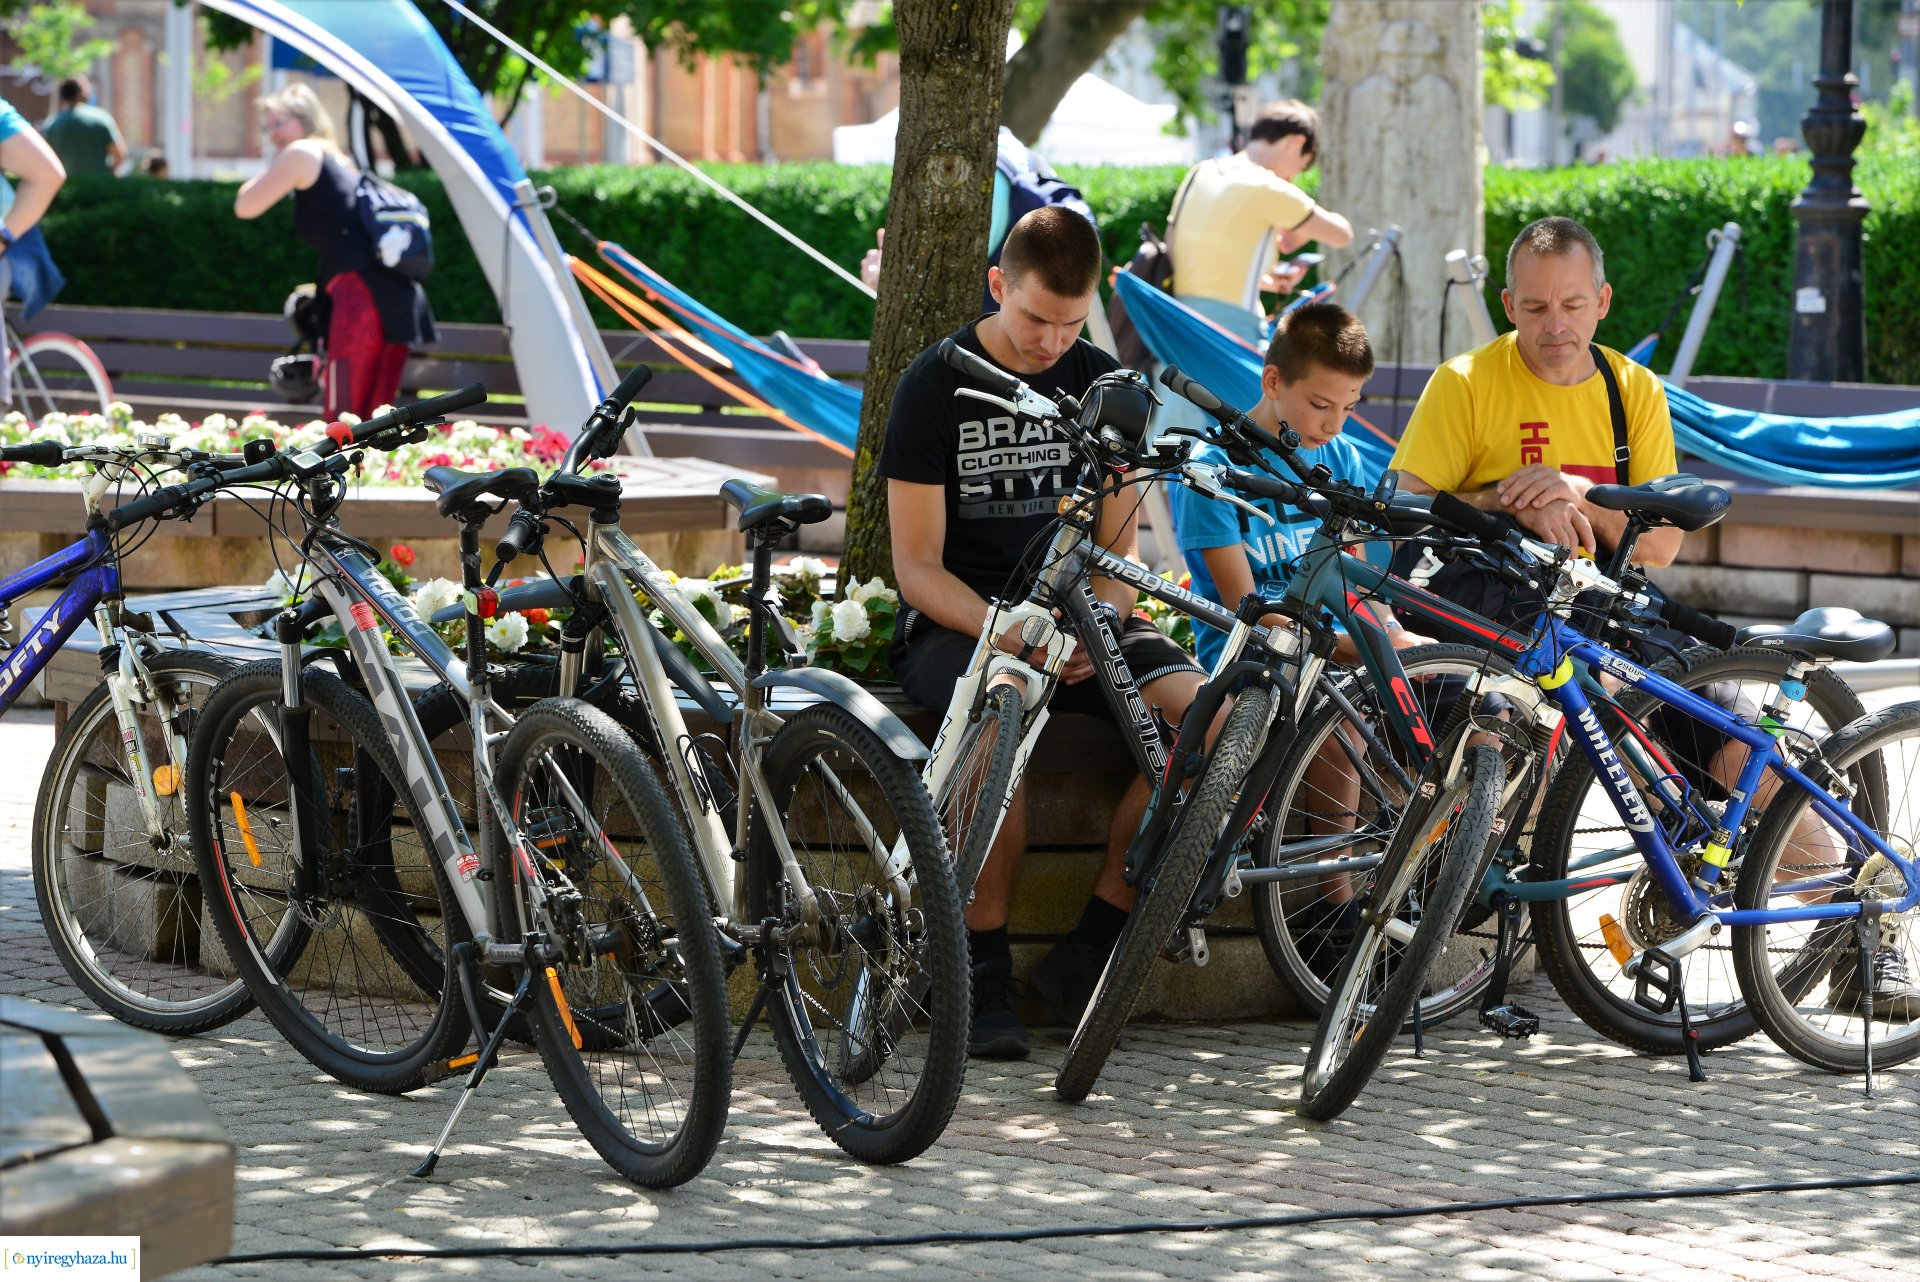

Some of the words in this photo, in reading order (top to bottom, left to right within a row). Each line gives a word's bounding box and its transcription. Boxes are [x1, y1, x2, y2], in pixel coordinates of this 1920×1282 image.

[959, 416, 1054, 451] BRA
[961, 448, 1061, 471] CLOTHING
[960, 467, 1075, 503] STYL
[988, 504, 1015, 515] NEW
[1022, 500, 1044, 511] YORK
[1097, 556, 1227, 616] magellan
[1391, 676, 1435, 762] CT
[1580, 706, 1649, 824] WHEELER
